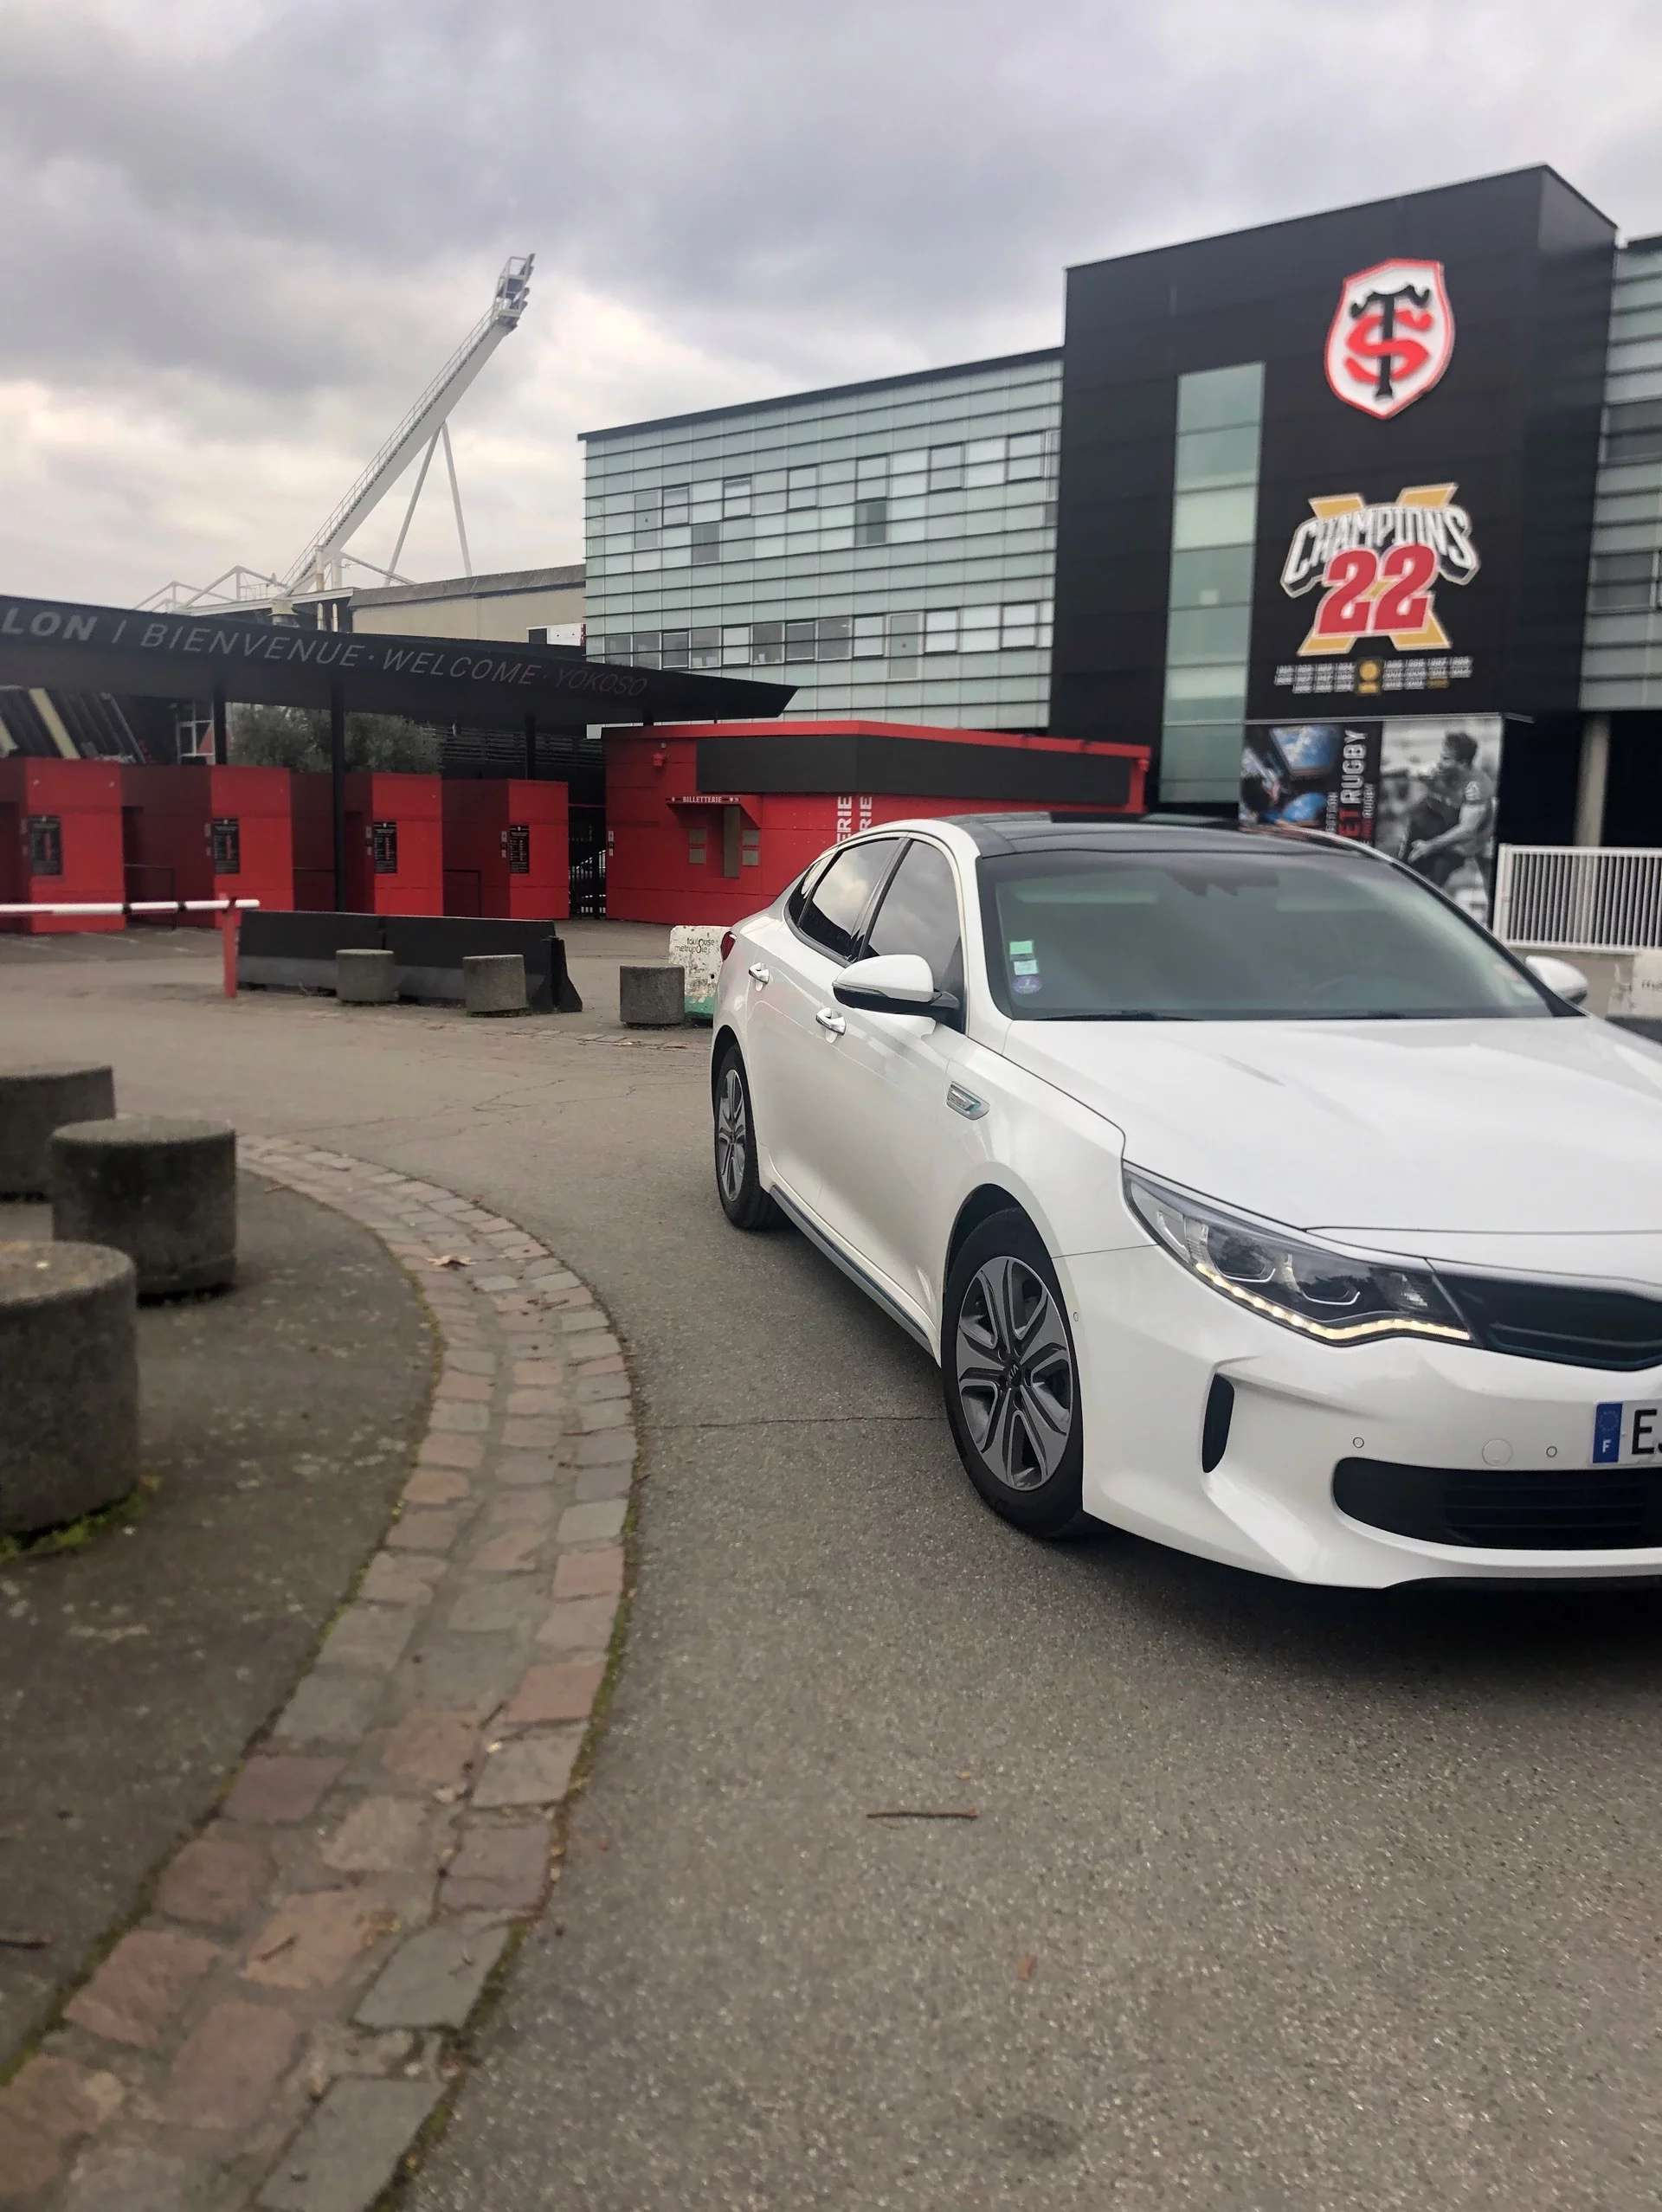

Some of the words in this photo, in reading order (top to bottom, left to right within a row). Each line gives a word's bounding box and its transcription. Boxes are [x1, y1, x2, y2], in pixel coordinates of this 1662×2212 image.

[1283, 504, 1478, 587] CHAMPIONS
[1317, 543, 1437, 636] 22
[140, 622, 365, 667] BIENVENUE
[383, 648, 542, 685] WELCOME
[1340, 730, 1367, 804] RUGBY
[1602, 1439, 1612, 1454] F
[1632, 1409, 1662, 1455] E
